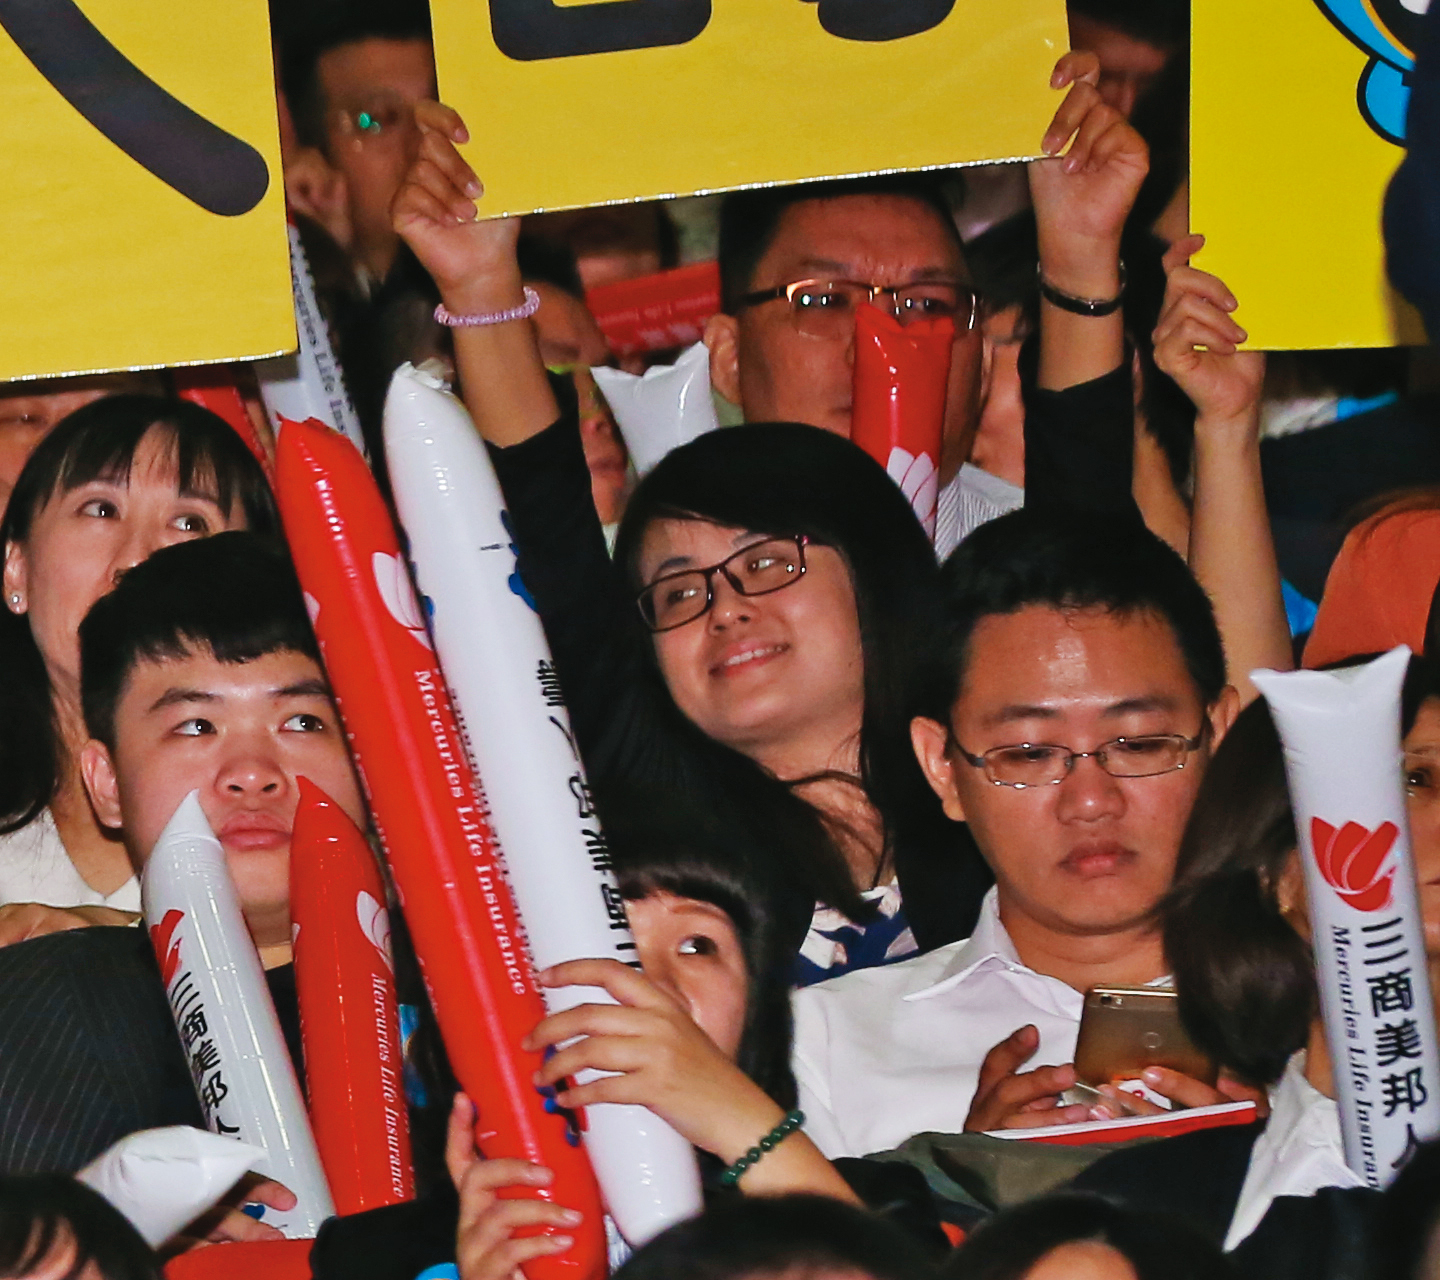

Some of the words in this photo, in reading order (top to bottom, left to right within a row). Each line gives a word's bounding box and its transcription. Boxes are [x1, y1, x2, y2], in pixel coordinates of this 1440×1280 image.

[414, 669, 465, 798] Mercuries
[456, 804, 483, 857] Life
[476, 864, 527, 996] Insurance
[370, 972, 391, 1069] Mercuries
[1331, 925, 1361, 1040] Mercuries
[1348, 1045, 1372, 1092] Life
[380, 1067, 397, 1103] Life
[384, 1105, 405, 1198] Insurance
